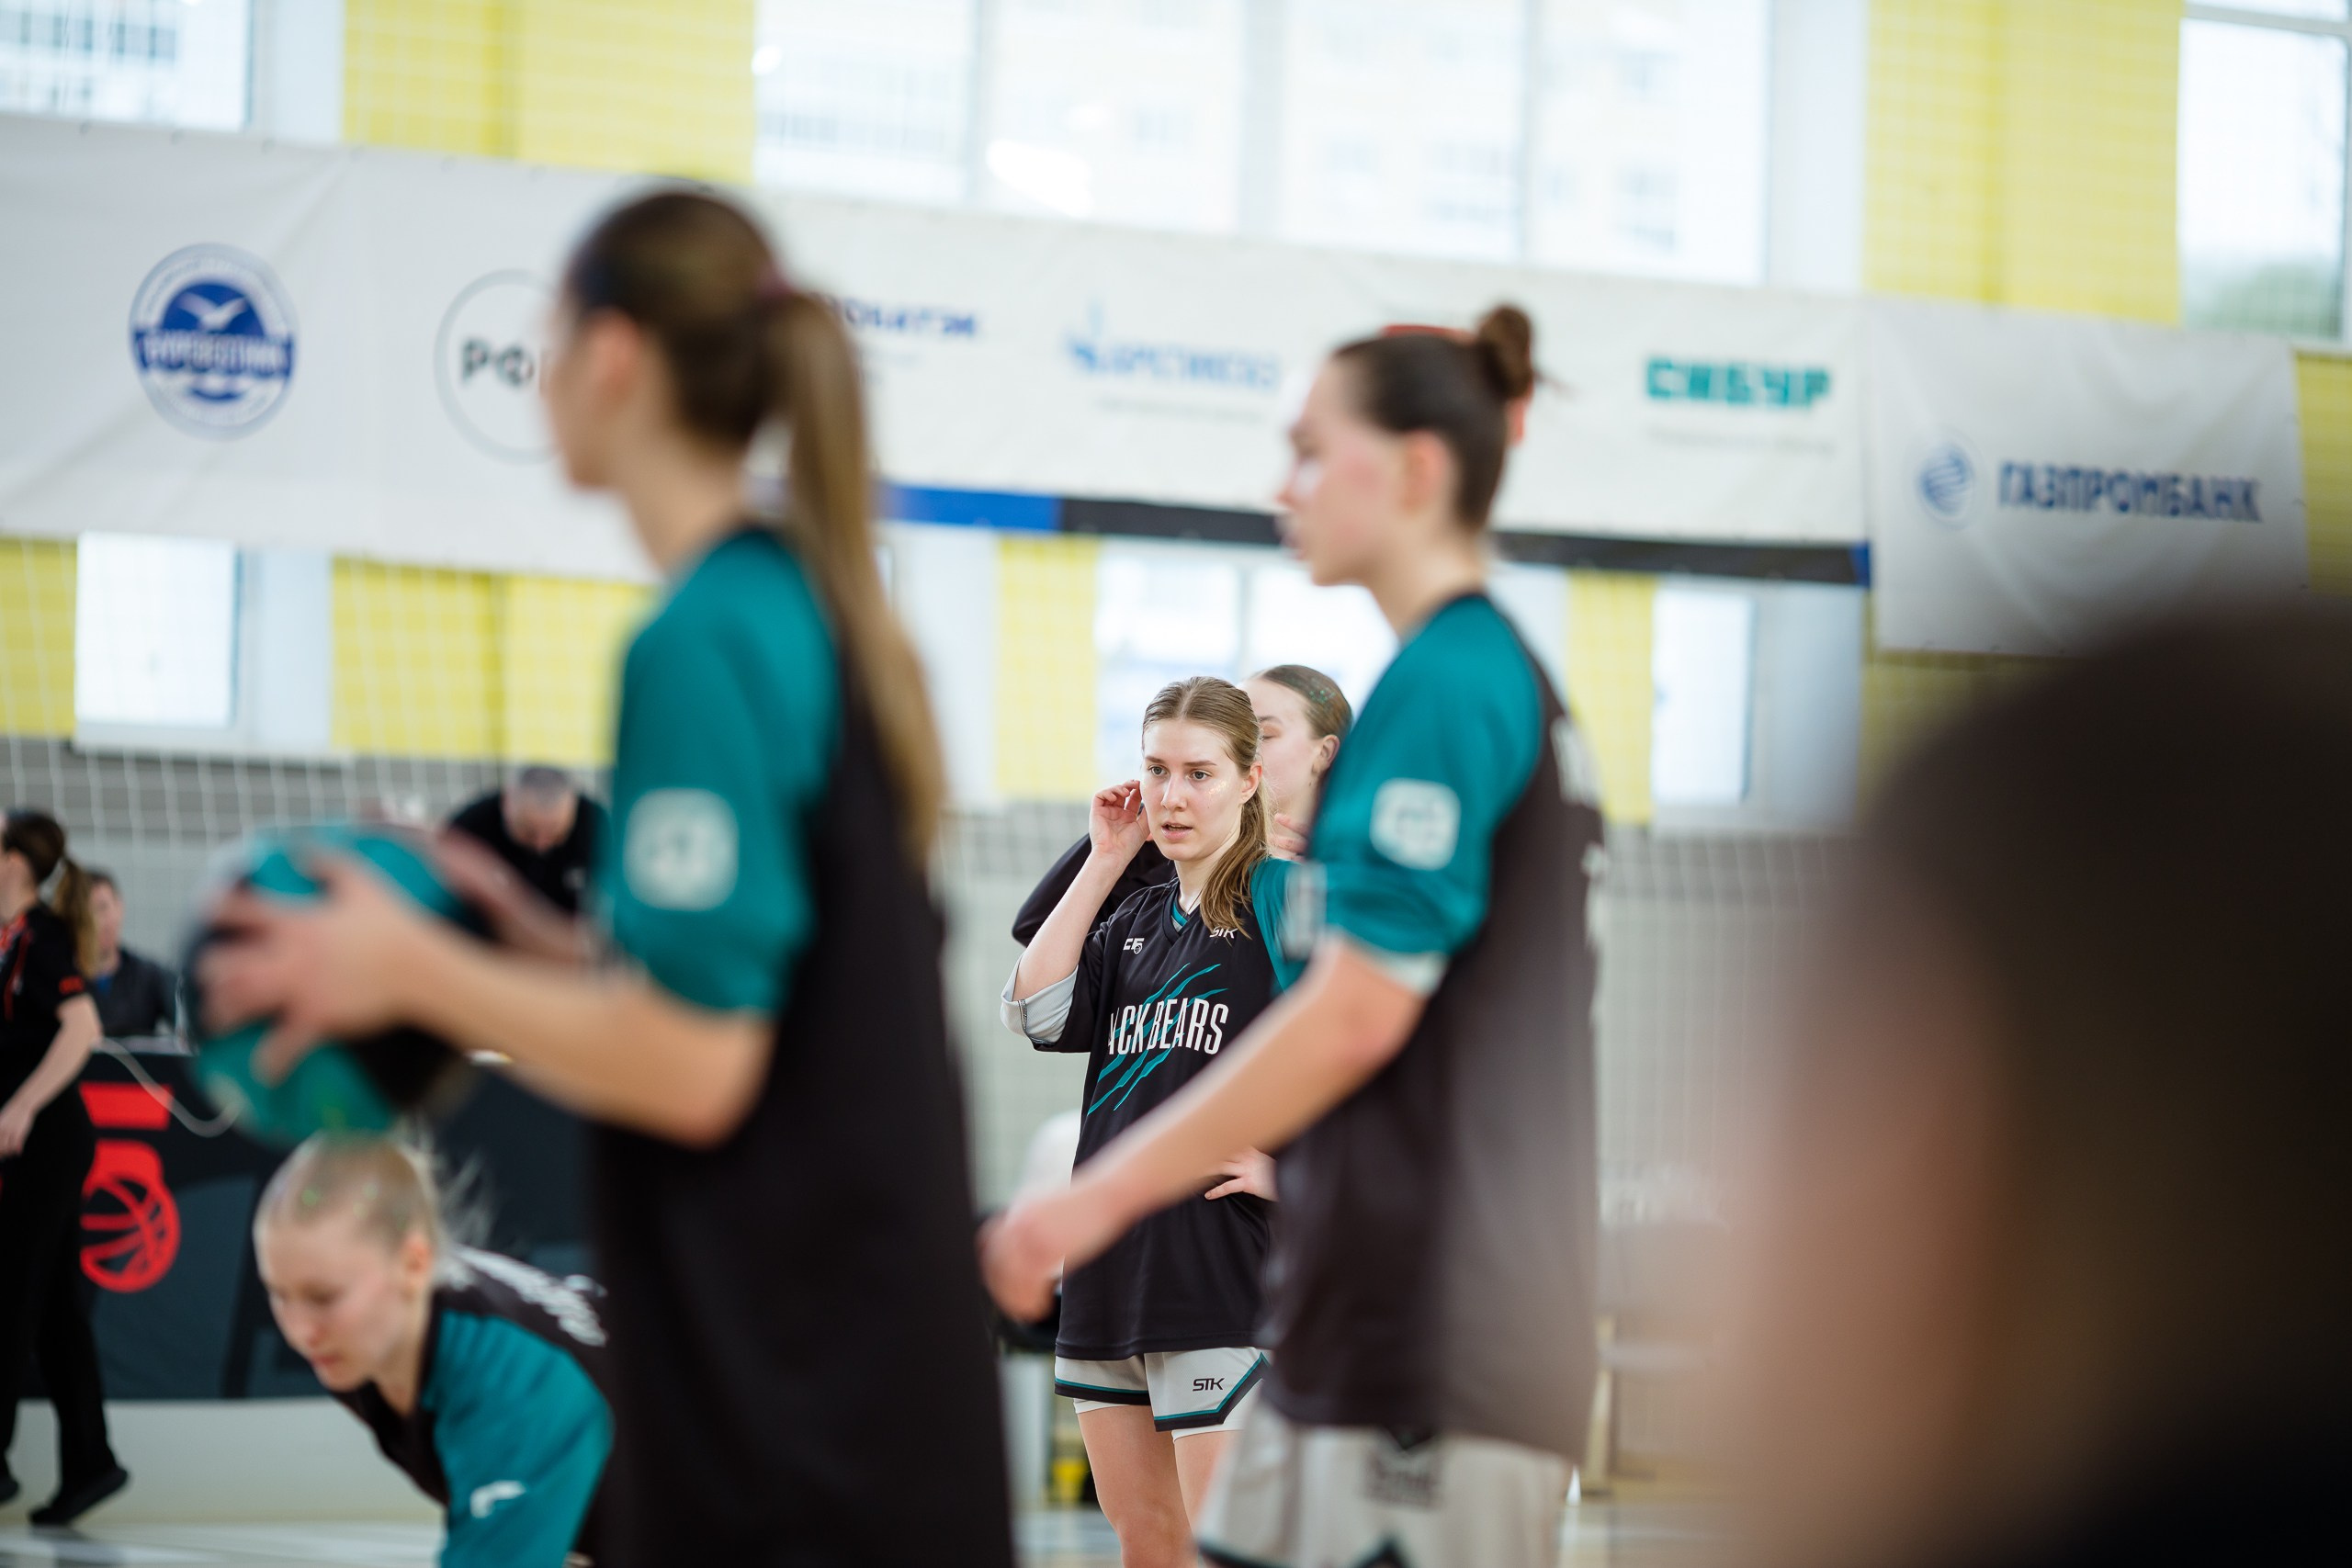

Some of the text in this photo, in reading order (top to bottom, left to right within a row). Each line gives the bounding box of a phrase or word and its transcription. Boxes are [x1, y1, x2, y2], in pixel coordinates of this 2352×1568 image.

[1645, 355, 1832, 411] СИБУР
[1999, 461, 2262, 523] ГАЗПРОМБАНК
[1147, 998, 1229, 1055] BEARS
[1193, 1377, 1225, 1392] STK
